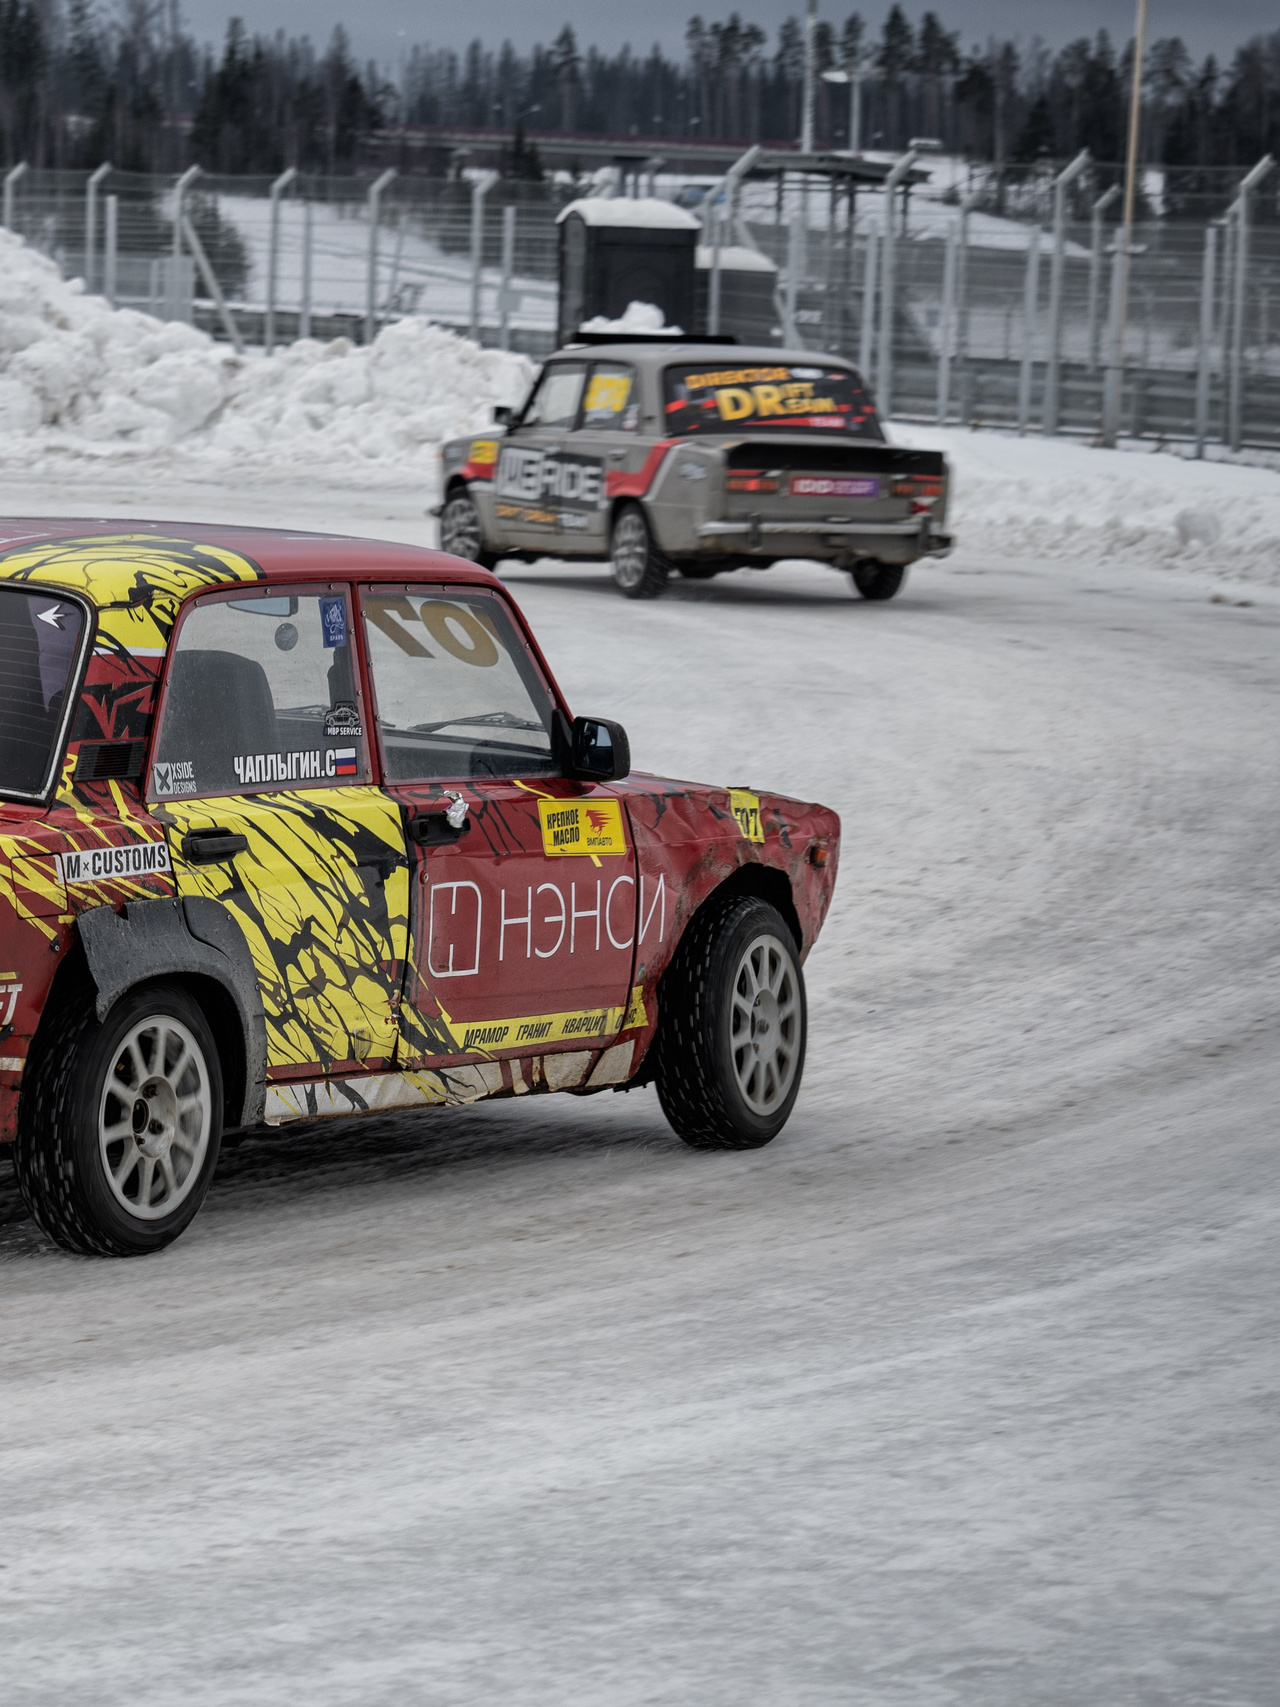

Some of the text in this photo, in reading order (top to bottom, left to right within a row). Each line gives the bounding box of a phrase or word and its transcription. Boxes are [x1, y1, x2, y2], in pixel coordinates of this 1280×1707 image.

[340, 726, 363, 736] SERVICE
[171, 761, 195, 780] XSIDE
[233, 749, 336, 784] ЧАПЛЫГИН.С
[173, 780, 197, 795] DESIGNS
[546, 808, 580, 830] КРЕПКОЕ
[553, 826, 580, 847] МАСЛО
[499, 872, 666, 962] НЭНСИ
[463, 1026, 510, 1046] МРАМОР
[515, 1021, 553, 1041] ГРАНИТ
[561, 1014, 607, 1037] КВАРЦИТ
